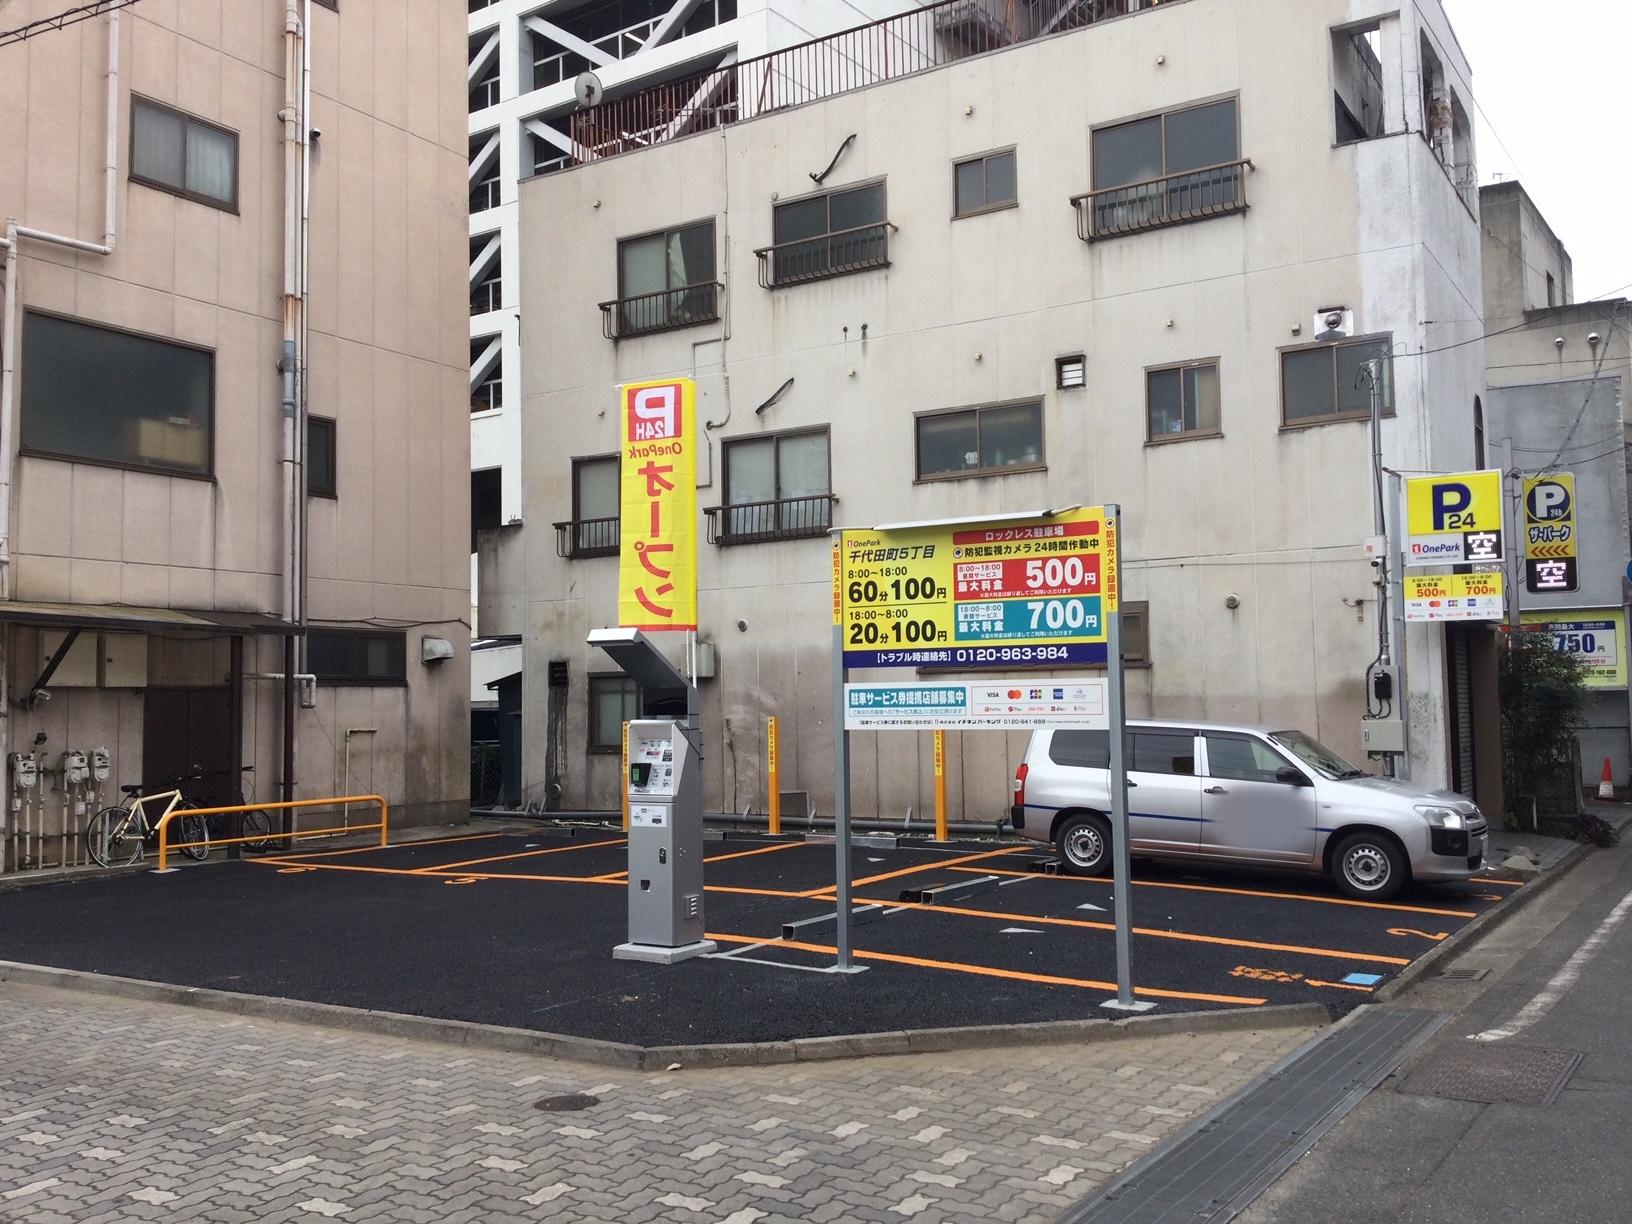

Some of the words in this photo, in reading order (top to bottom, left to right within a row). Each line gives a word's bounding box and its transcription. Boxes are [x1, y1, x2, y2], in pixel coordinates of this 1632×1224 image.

[1432, 483, 1471, 531] P
[1535, 485, 1565, 517] P
[1550, 509, 1563, 517] 24h
[1448, 512, 1476, 530] 24
[985, 526, 1064, 541] ロックレス駐車場
[1529, 525, 1570, 543] ザ・パーク
[853, 539, 881, 548] OnePark
[1422, 543, 1461, 554] OnePark
[1467, 531, 1497, 560] 空
[849, 545, 935, 564] 千代田町5丁目
[1026, 557, 1096, 588] 500円
[1536, 560, 1567, 588] 空
[958, 579, 1003, 592] 最大料金
[1417, 588, 1446, 597] 500円
[1466, 585, 1496, 595] 700円
[1027, 599, 1097, 629] 700円
[959, 620, 1004, 633] 最大料金
[957, 647, 1069, 662] 0120-963-984
[1386, 927, 1449, 941] 2
